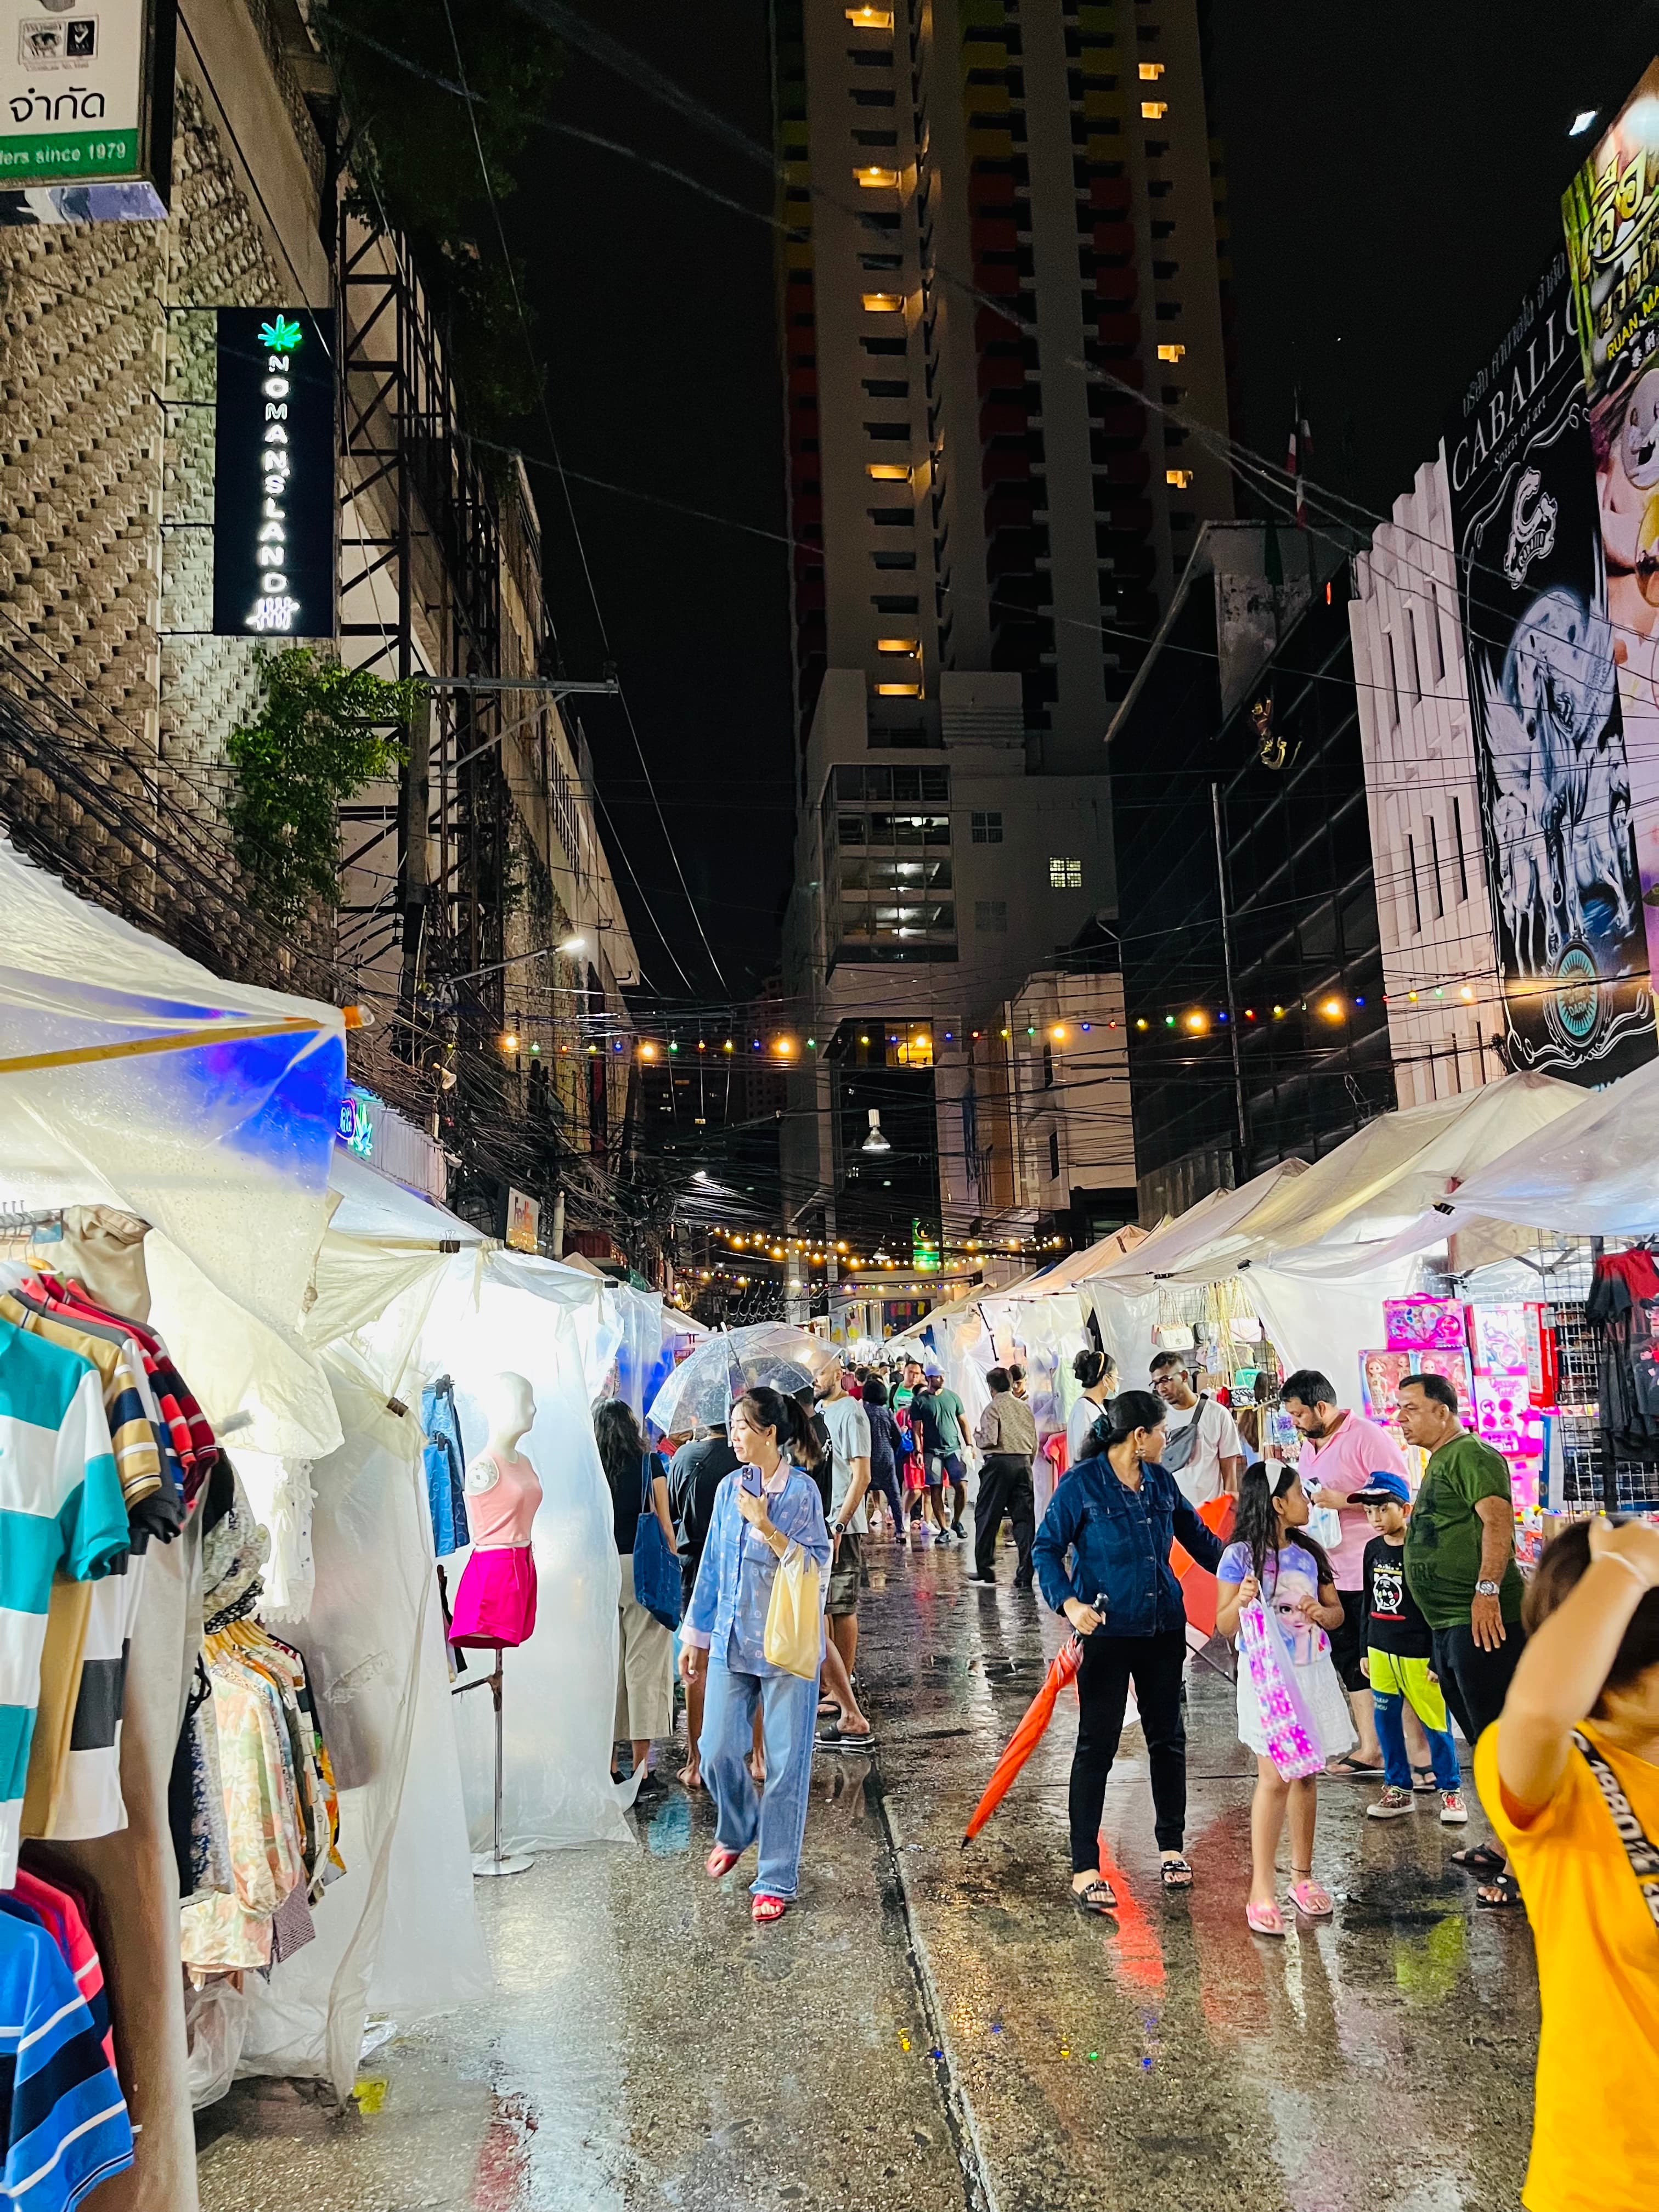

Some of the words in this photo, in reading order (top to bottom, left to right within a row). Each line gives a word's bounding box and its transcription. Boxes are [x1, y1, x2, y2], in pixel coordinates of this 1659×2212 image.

[9, 87, 105, 123] จำกัด
[35, 146, 81, 164] since
[89, 141, 126, 160] 1979
[1607, 312, 1639, 361] RUAN
